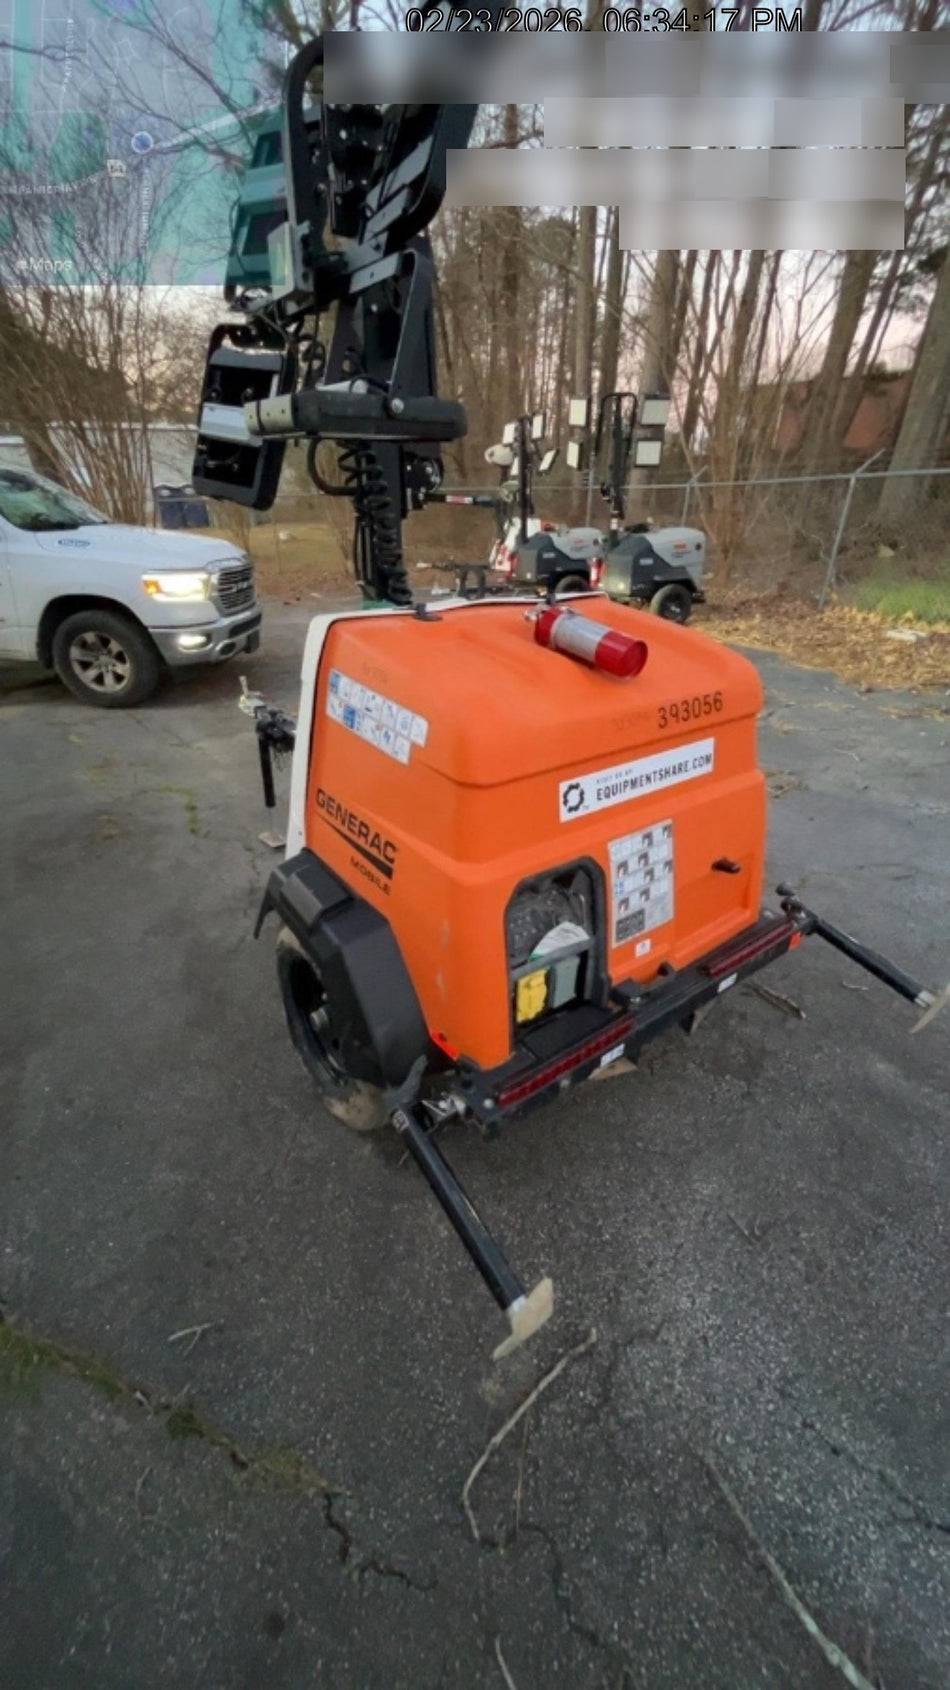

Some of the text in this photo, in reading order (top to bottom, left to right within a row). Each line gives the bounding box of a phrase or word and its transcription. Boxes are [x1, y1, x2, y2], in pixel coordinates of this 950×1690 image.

[658, 690, 723, 729] 393056
[596, 752, 712, 801] EQUIPMENTSHARE.COM
[315, 787, 398, 866] GENERAC
